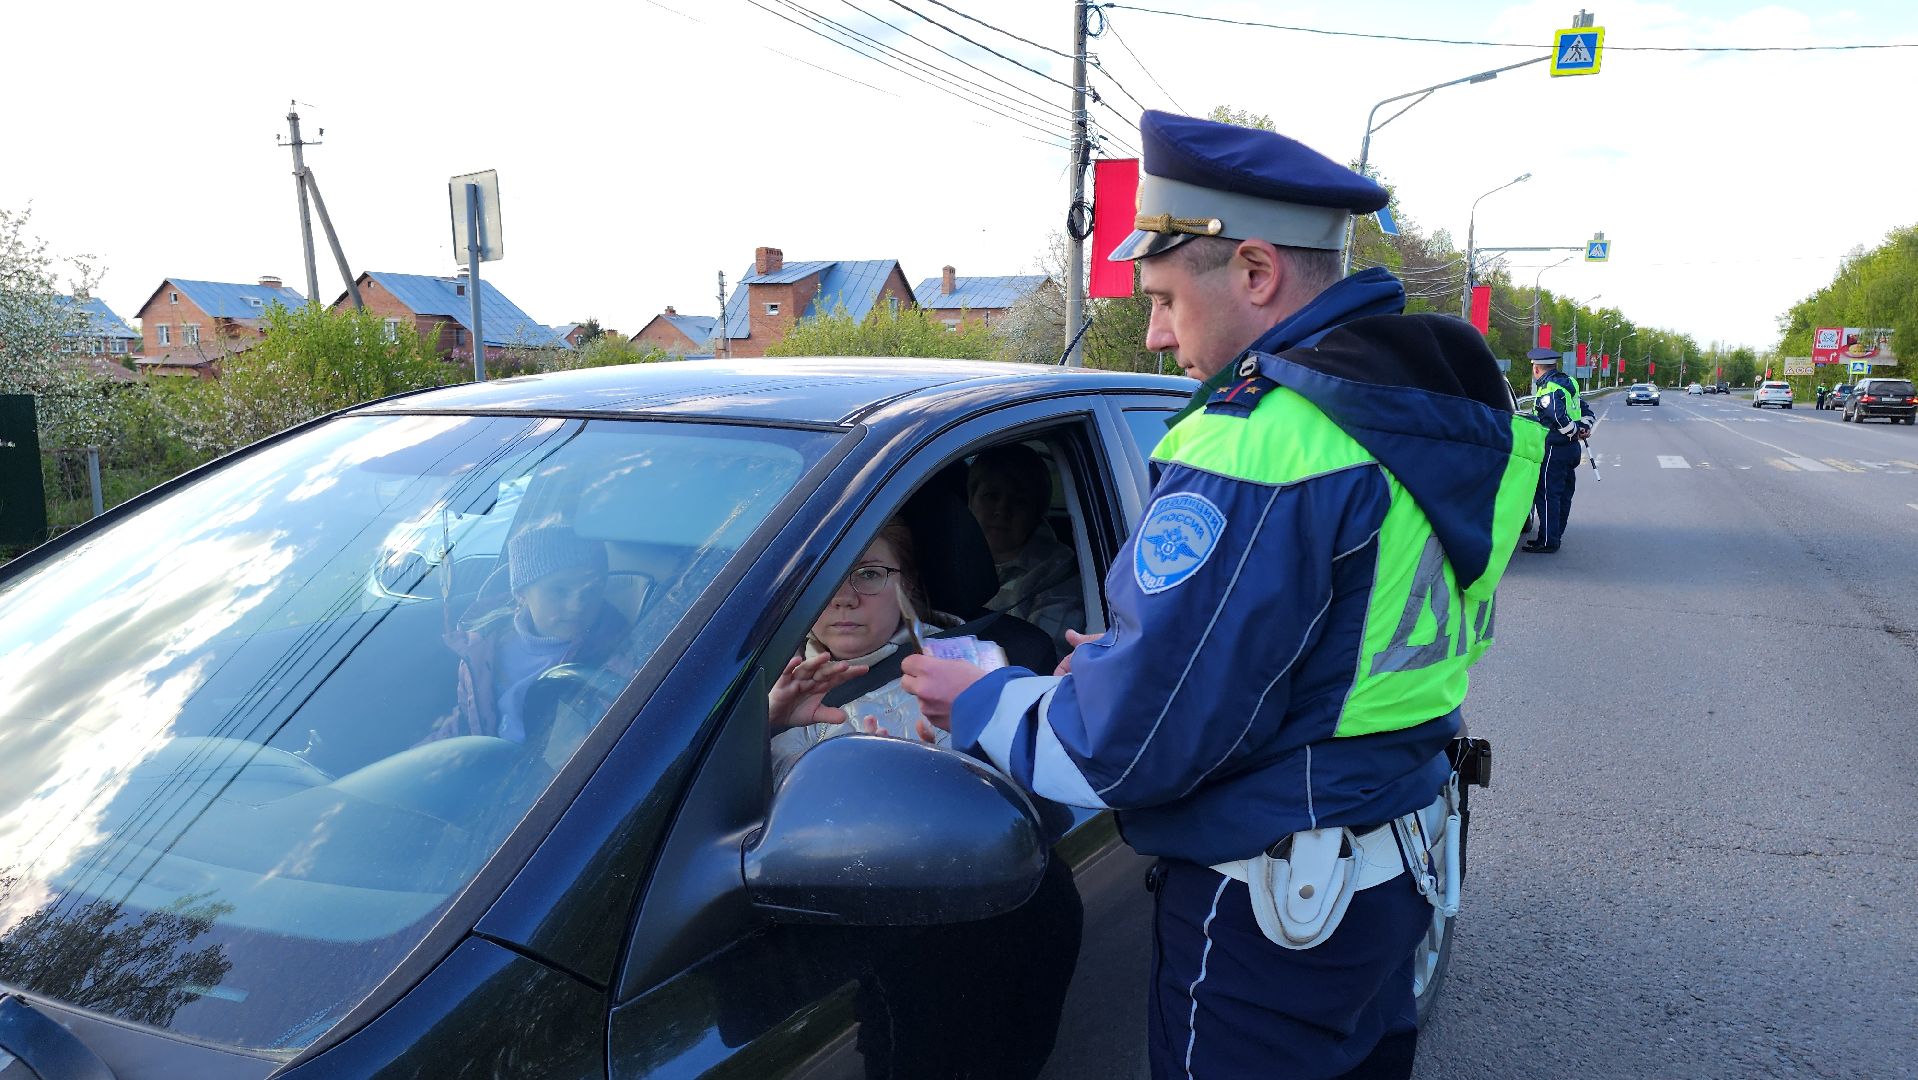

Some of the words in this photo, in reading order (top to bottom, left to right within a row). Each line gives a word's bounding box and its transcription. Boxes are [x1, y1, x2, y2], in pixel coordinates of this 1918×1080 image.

[1157, 512, 1205, 540] РОССИЯ
[1159, 497, 1219, 530] ПОЛИЦИЯ
[1141, 569, 1167, 588] МВД
